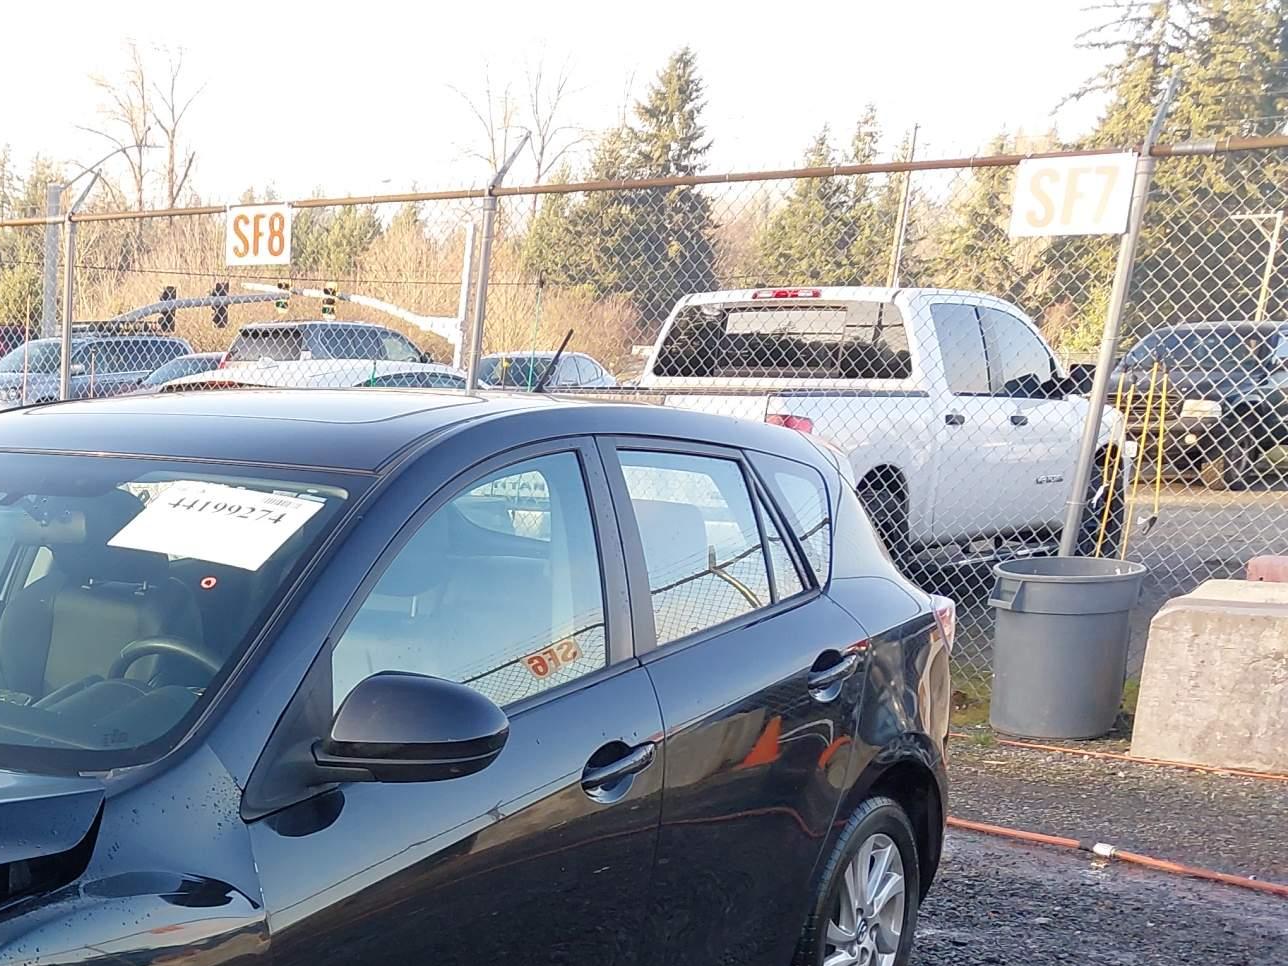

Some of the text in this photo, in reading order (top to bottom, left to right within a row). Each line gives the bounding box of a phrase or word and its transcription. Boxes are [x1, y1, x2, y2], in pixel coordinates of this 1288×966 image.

[1025, 165, 1120, 229] SF7
[232, 211, 285, 258] SF8
[168, 497, 288, 525] 44199274
